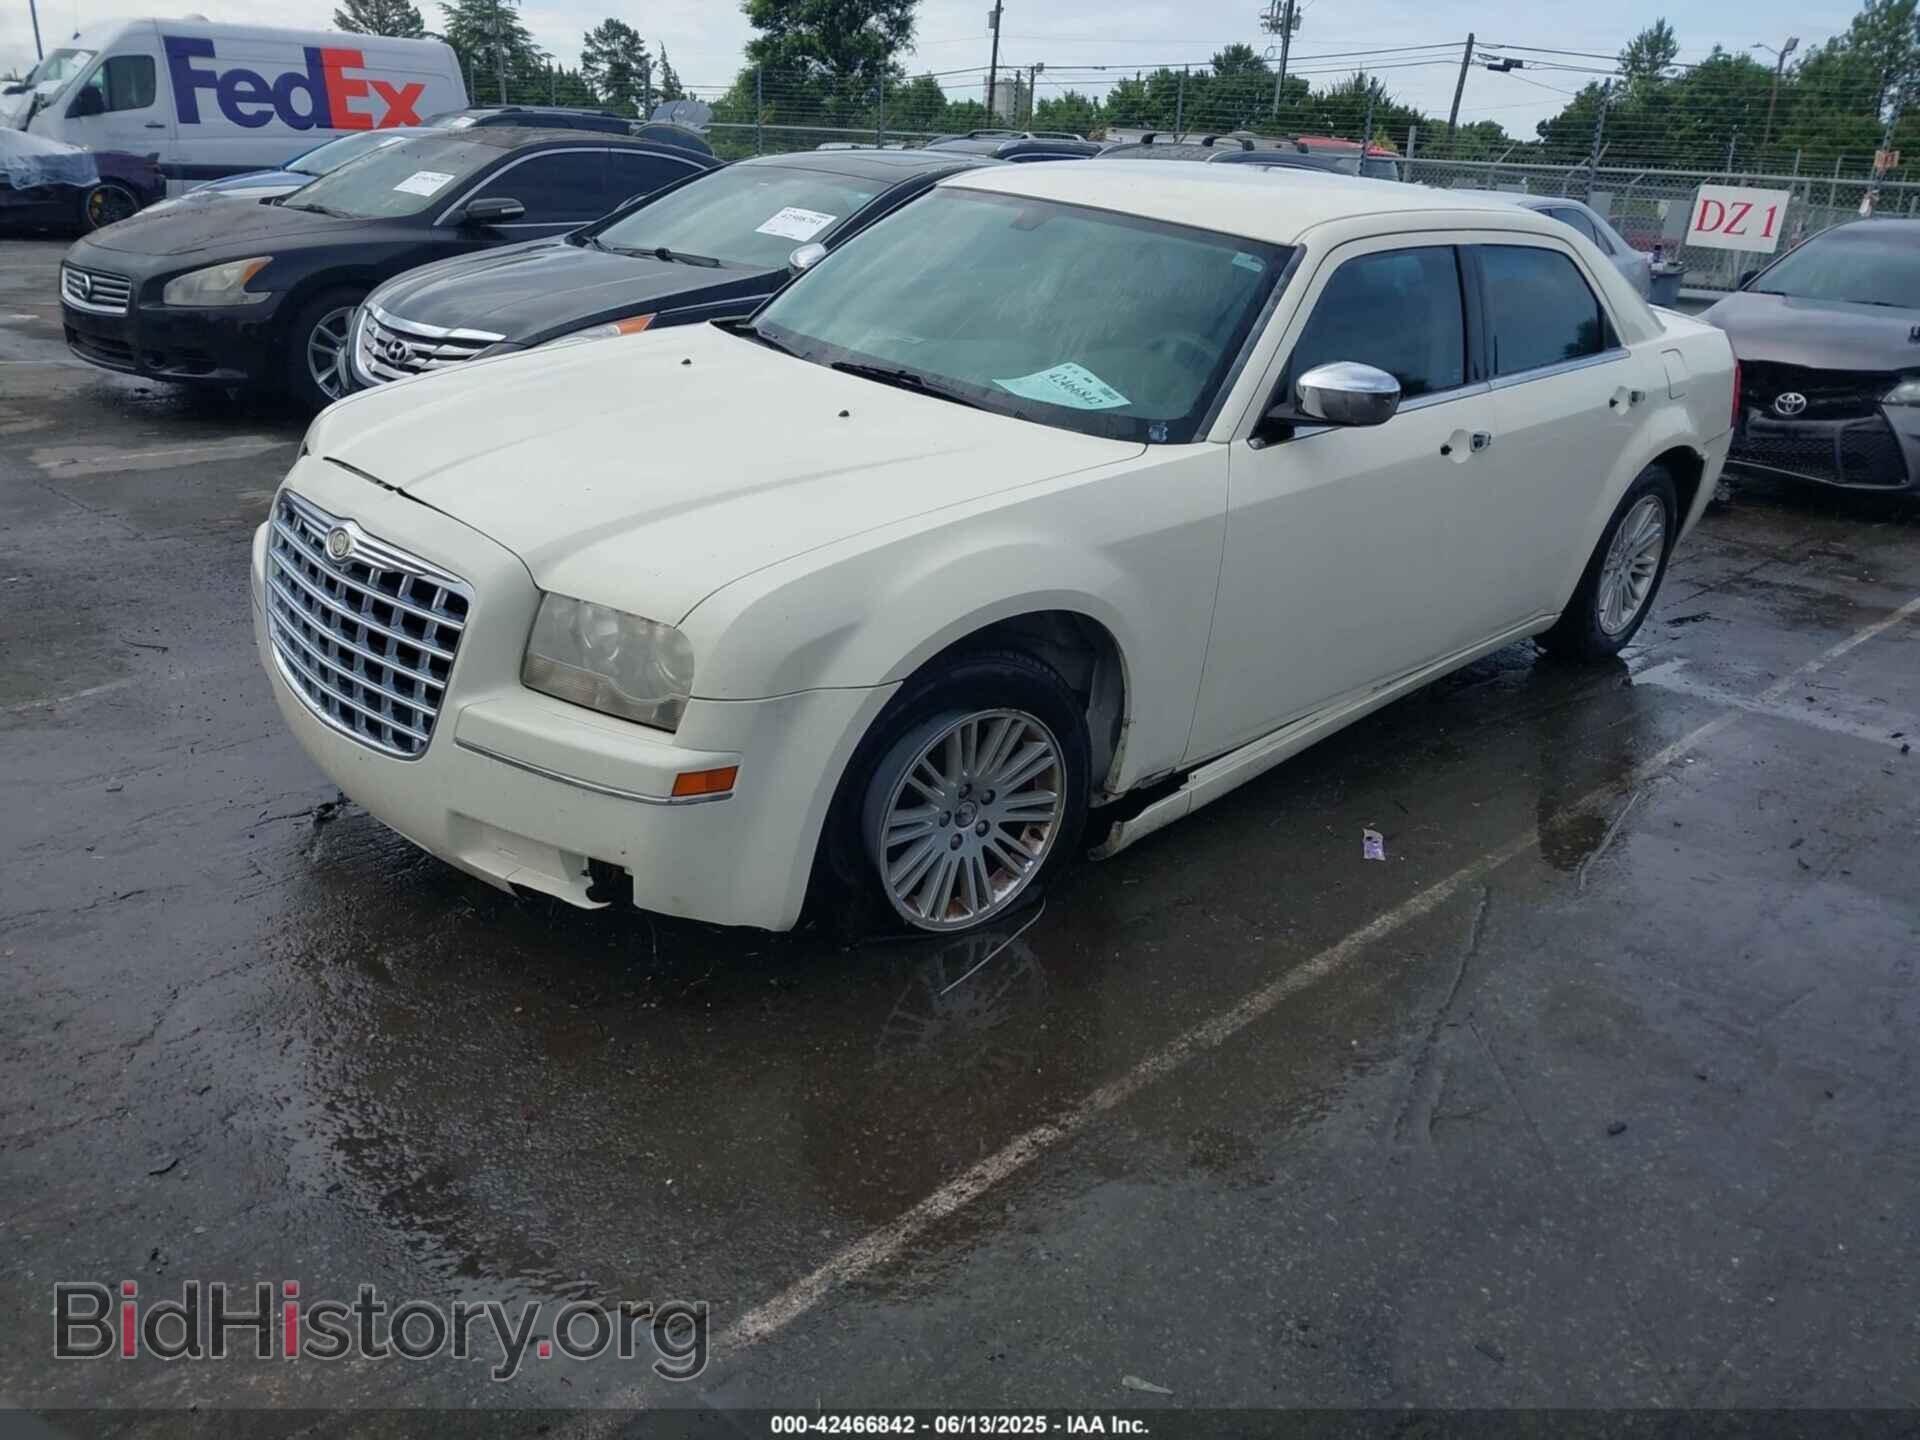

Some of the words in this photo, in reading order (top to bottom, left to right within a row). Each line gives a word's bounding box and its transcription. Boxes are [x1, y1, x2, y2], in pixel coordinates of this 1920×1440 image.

[163, 35, 427, 131] FedEx
[1694, 199, 1754, 236] DZ
[1760, 205, 1778, 238] 1
